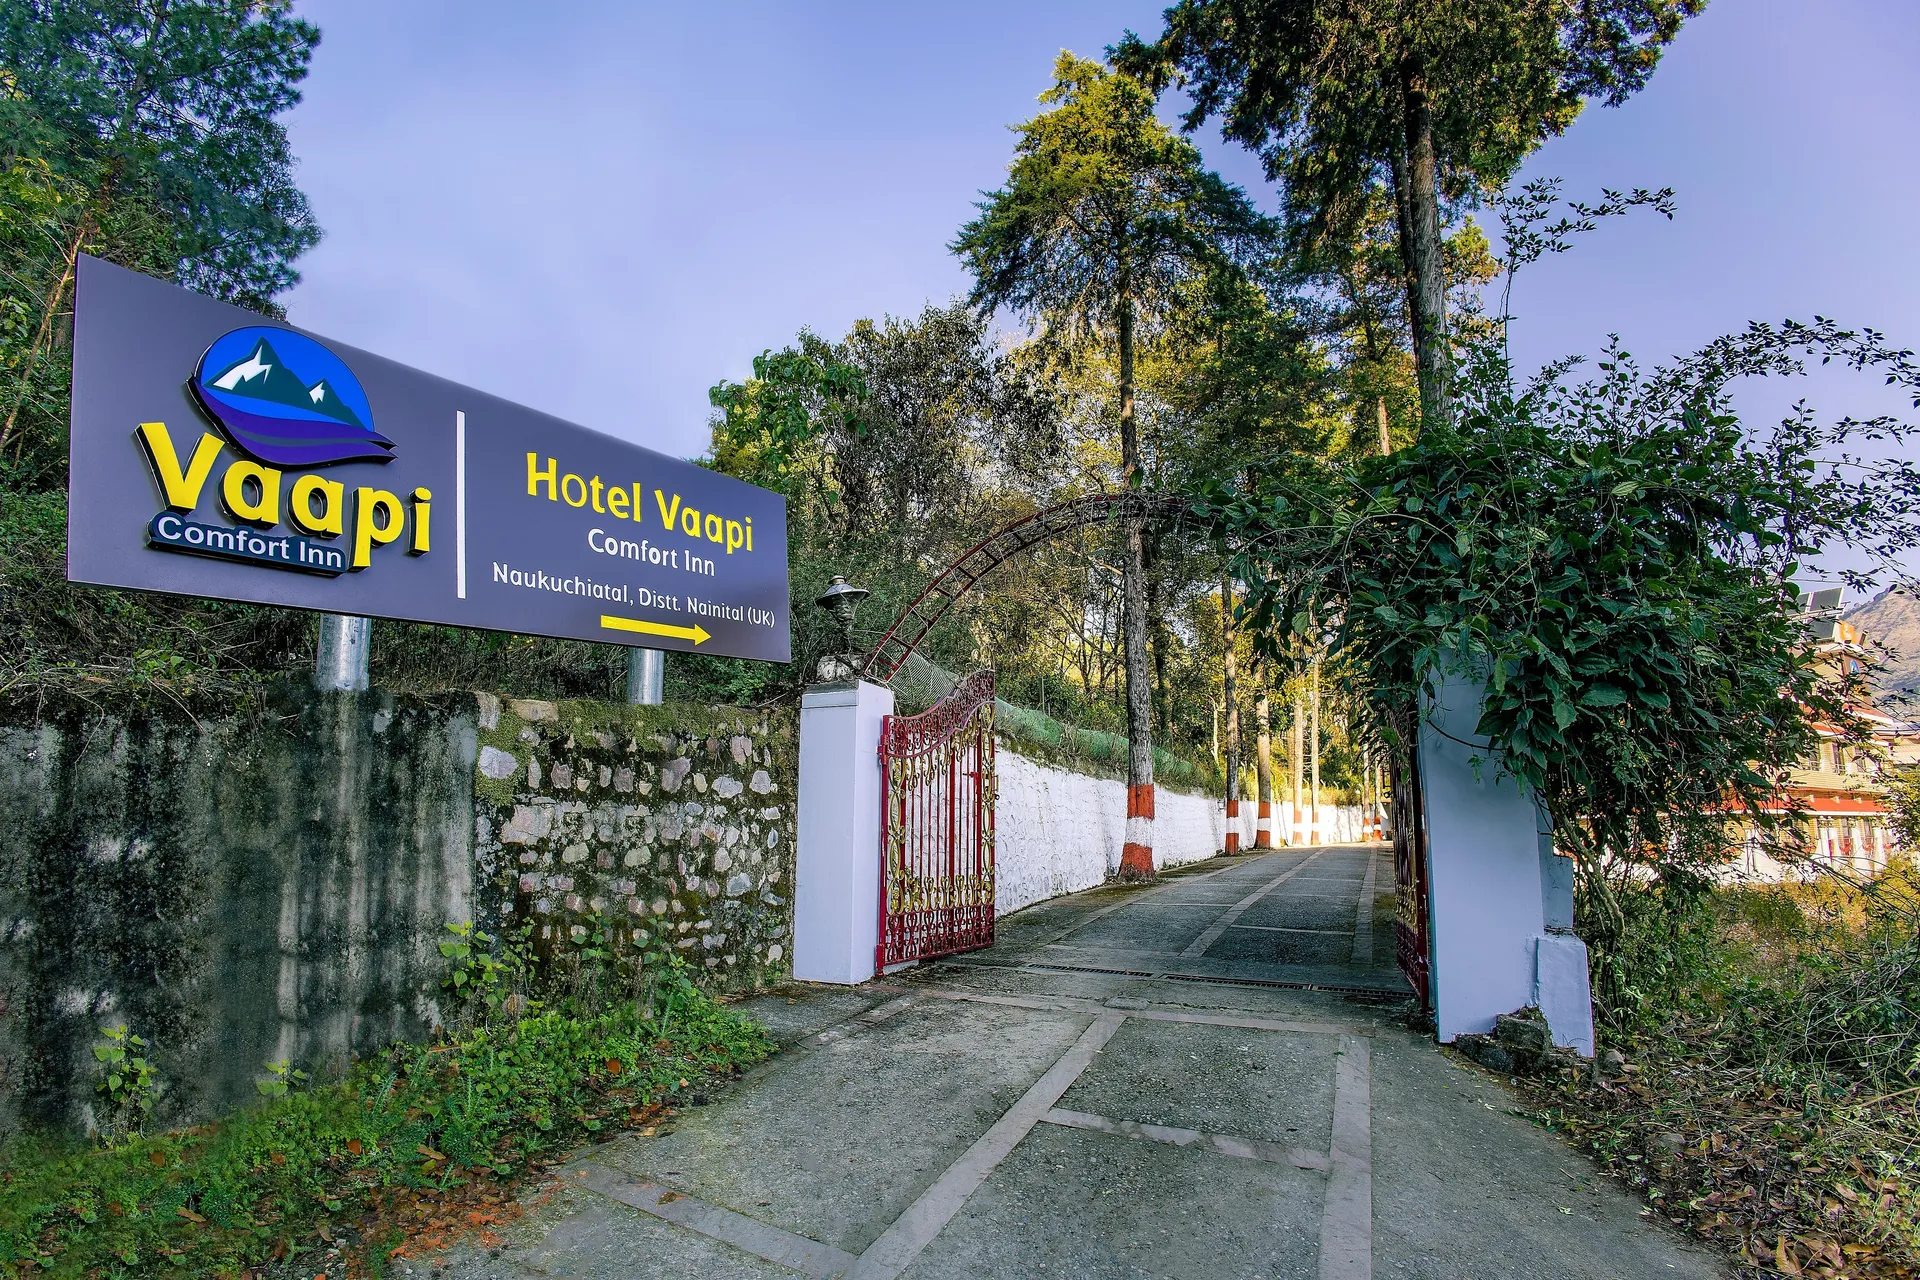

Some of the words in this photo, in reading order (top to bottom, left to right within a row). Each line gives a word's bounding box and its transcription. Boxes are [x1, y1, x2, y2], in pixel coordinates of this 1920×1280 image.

[137, 422, 432, 567] Vaapi
[526, 452, 642, 522] Hotel
[654, 489, 752, 554] Vaapi
[157, 516, 290, 559] Comfort
[299, 541, 342, 568] Inn
[588, 528, 678, 569] Comfort
[684, 550, 715, 576] Inn
[493, 561, 635, 605] Naukuchiatal,
[639, 587, 682, 611] Distt.
[687, 597, 744, 622] Nainital
[747, 606, 776, 628] (UK)
